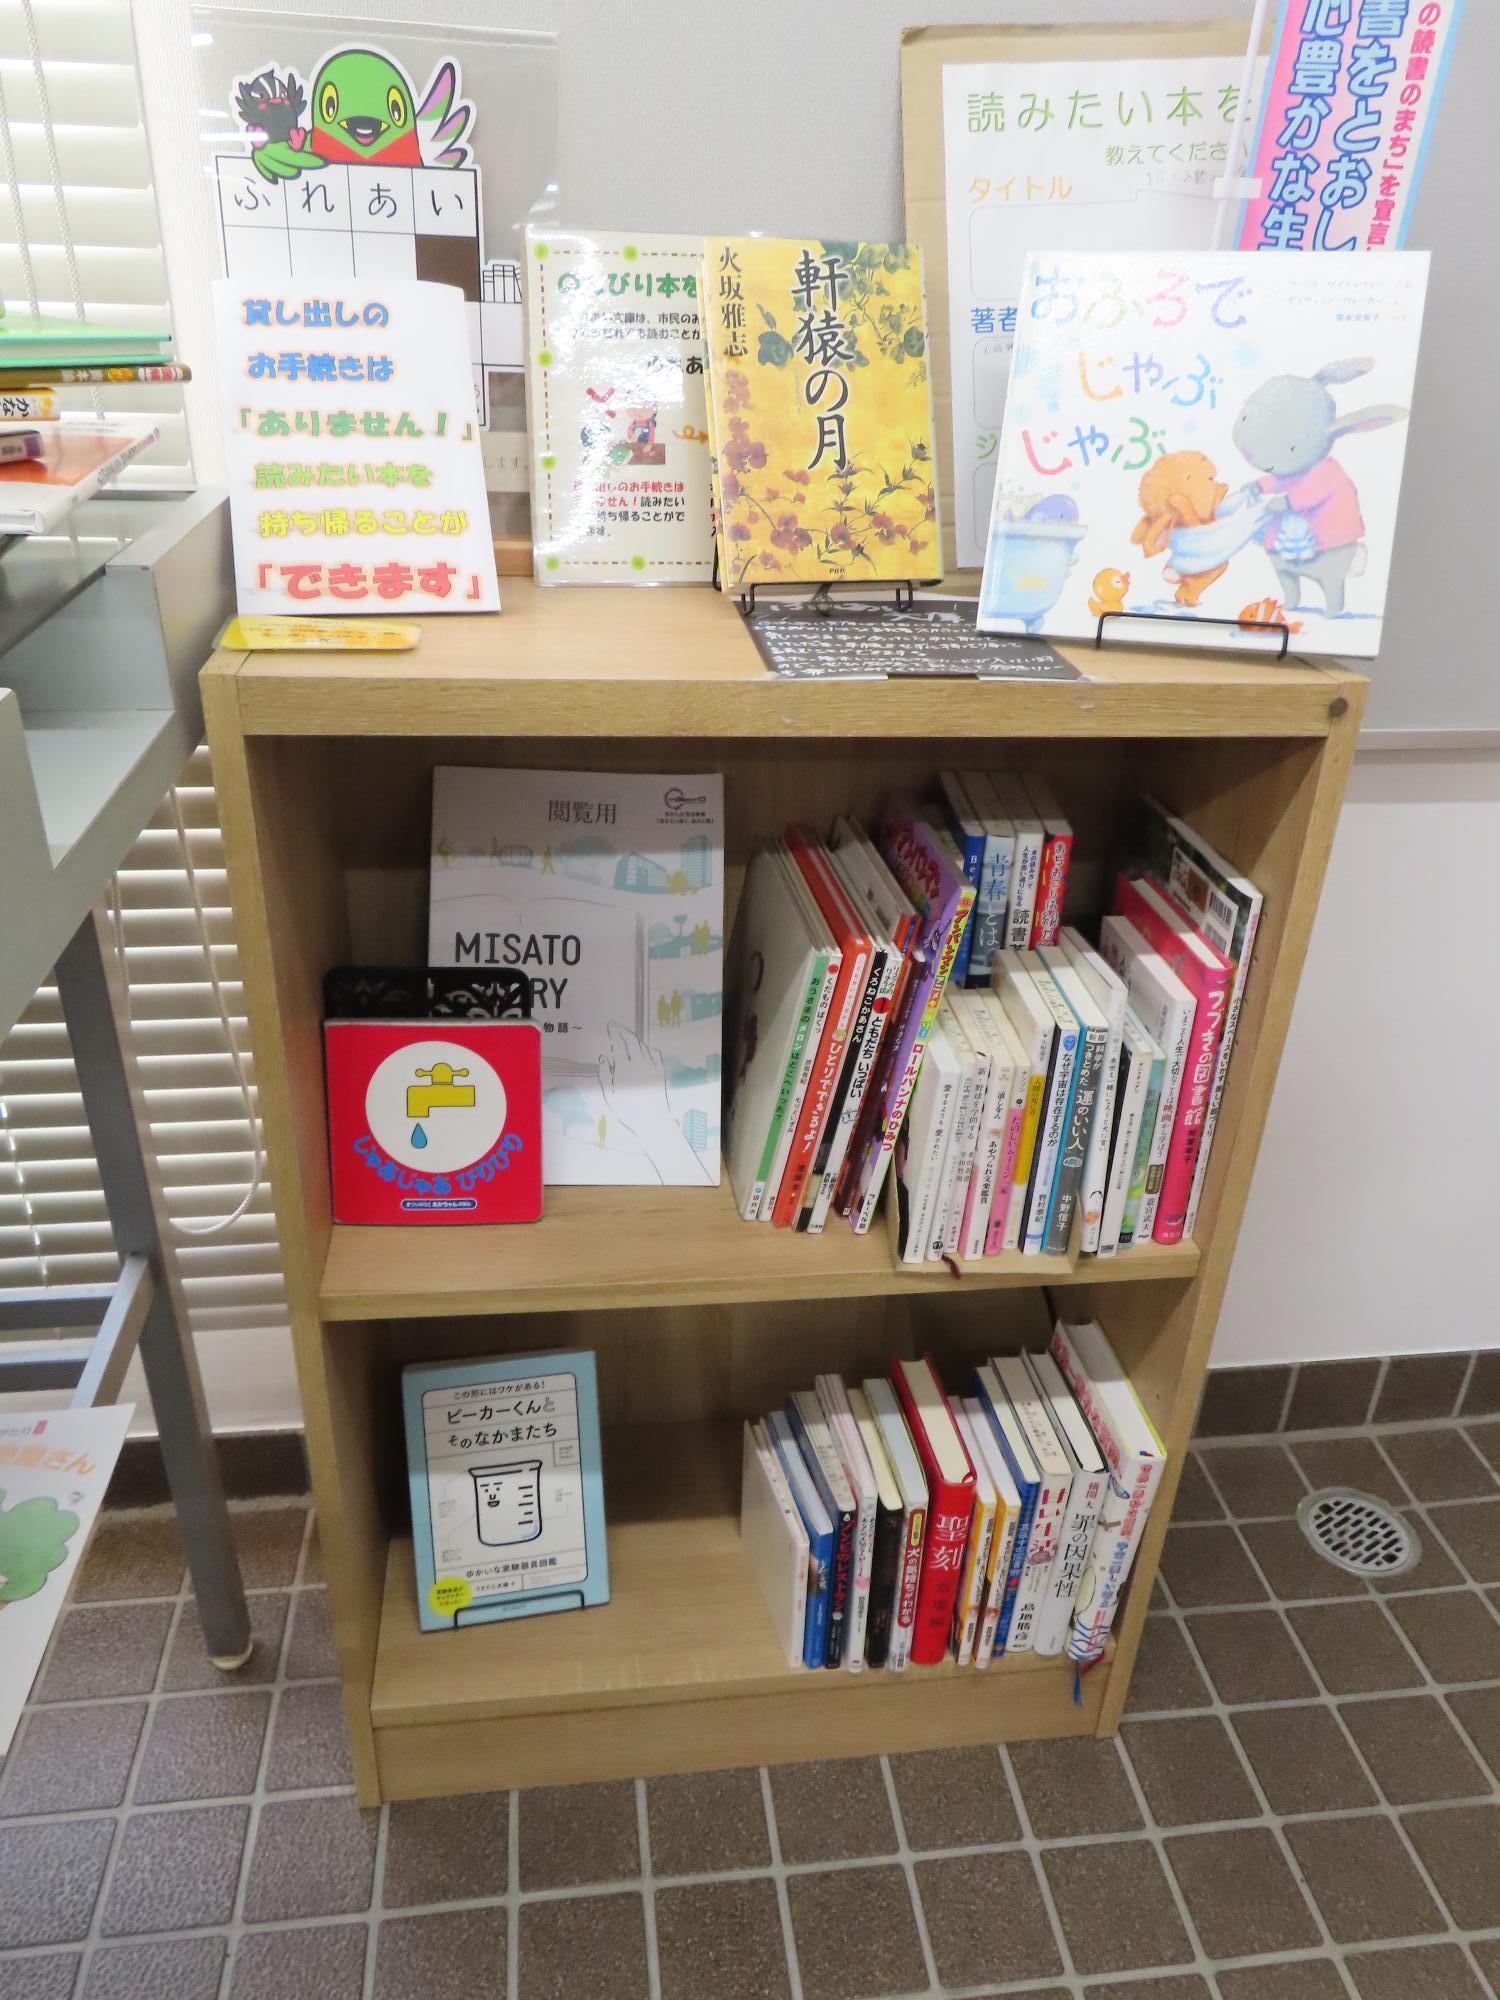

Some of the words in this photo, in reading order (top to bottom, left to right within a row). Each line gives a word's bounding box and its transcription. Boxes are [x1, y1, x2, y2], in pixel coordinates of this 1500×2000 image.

[966, 83, 1253, 134] 読みたい本を
[1366, 3, 1442, 251] の読書のまち」を宣言
[234, 176, 463, 219] ふれあい
[968, 175, 1073, 203] タイトル
[557, 272, 698, 299] のびり本を
[718, 245, 749, 357] 火坂雅志
[1030, 265, 1254, 330] おふろで
[243, 299, 390, 328] 貸し出しの
[247, 351, 395, 382] お手続きは
[791, 249, 855, 471] 軒猿の月
[1078, 352, 1225, 409] じゃぶ
[239, 407, 473, 442] 「ありません！」
[1021, 416, 1168, 477] じゃぶ
[254, 462, 433, 490] 読みたい本を
[257, 510, 469, 538] 持ち帰ることが
[257, 561, 481, 600] 「できます」
[548, 800, 617, 825] 閲覧用
[978, 853, 1010, 948] 青春とは
[454, 931, 582, 966] MISATO
[851, 966, 882, 1044] くろねこかあさん
[861, 1015, 883, 1060] ともだち
[1184, 990, 1226, 1127] つづきの図書館
[851, 1060, 873, 1100] いっぱい
[881, 1043, 925, 1152] ロールパンナのひみつ
[1047, 1053, 1071, 1148] なぜ宇宙は存在するのか
[1056, 1194, 1072, 1232] 中野信子
[447, 1396, 556, 1425] ビーカーくんと
[448, 1422, 558, 1449] そのなかまたち
[1054, 1513, 1096, 1598] 罪の因果性
